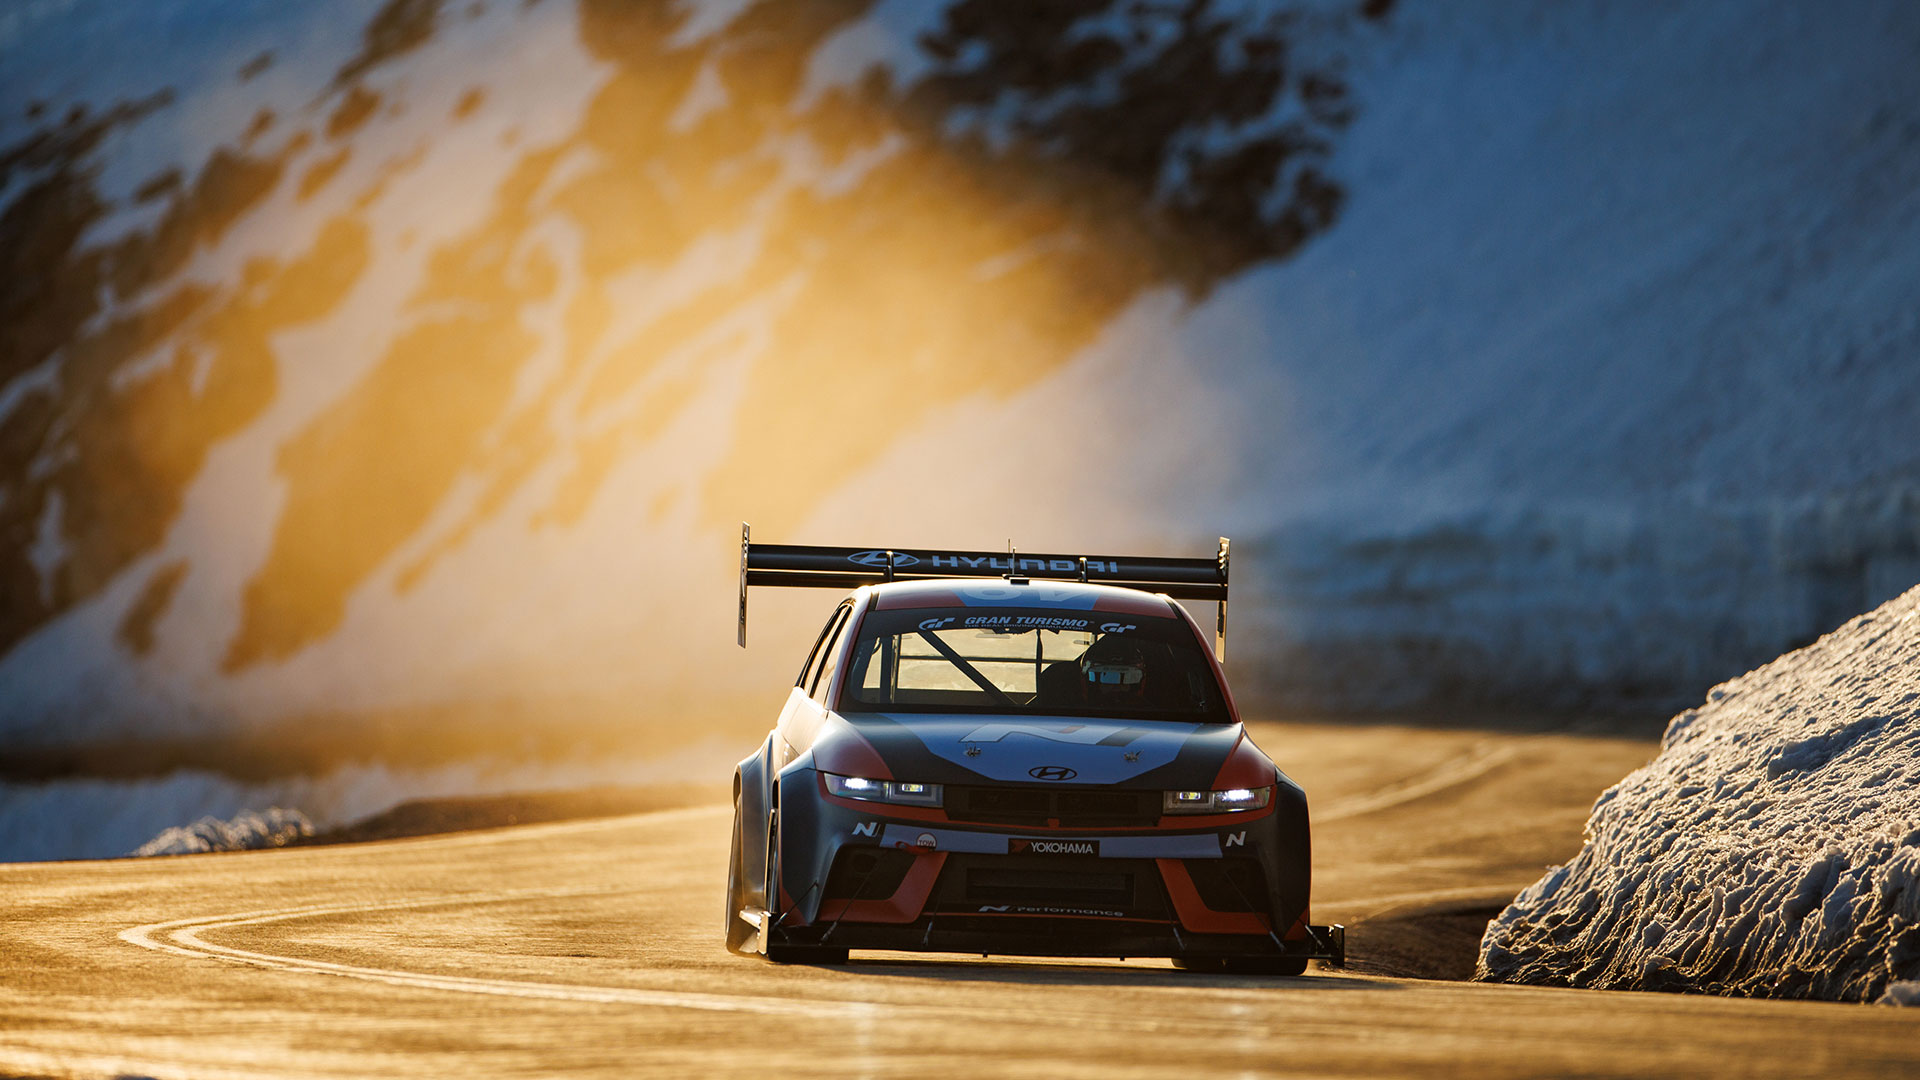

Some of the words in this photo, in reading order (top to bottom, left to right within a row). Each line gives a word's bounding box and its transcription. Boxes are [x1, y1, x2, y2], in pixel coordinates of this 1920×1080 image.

[932, 555, 1118, 573] HYUNDAI
[964, 616, 1012, 625] GRAN
[1016, 616, 1088, 628] TURISMO
[851, 822, 878, 837] N
[1225, 831, 1247, 847] N
[1030, 842, 1093, 854] YOKOHAMA
[1017, 906, 1123, 917] Performance
